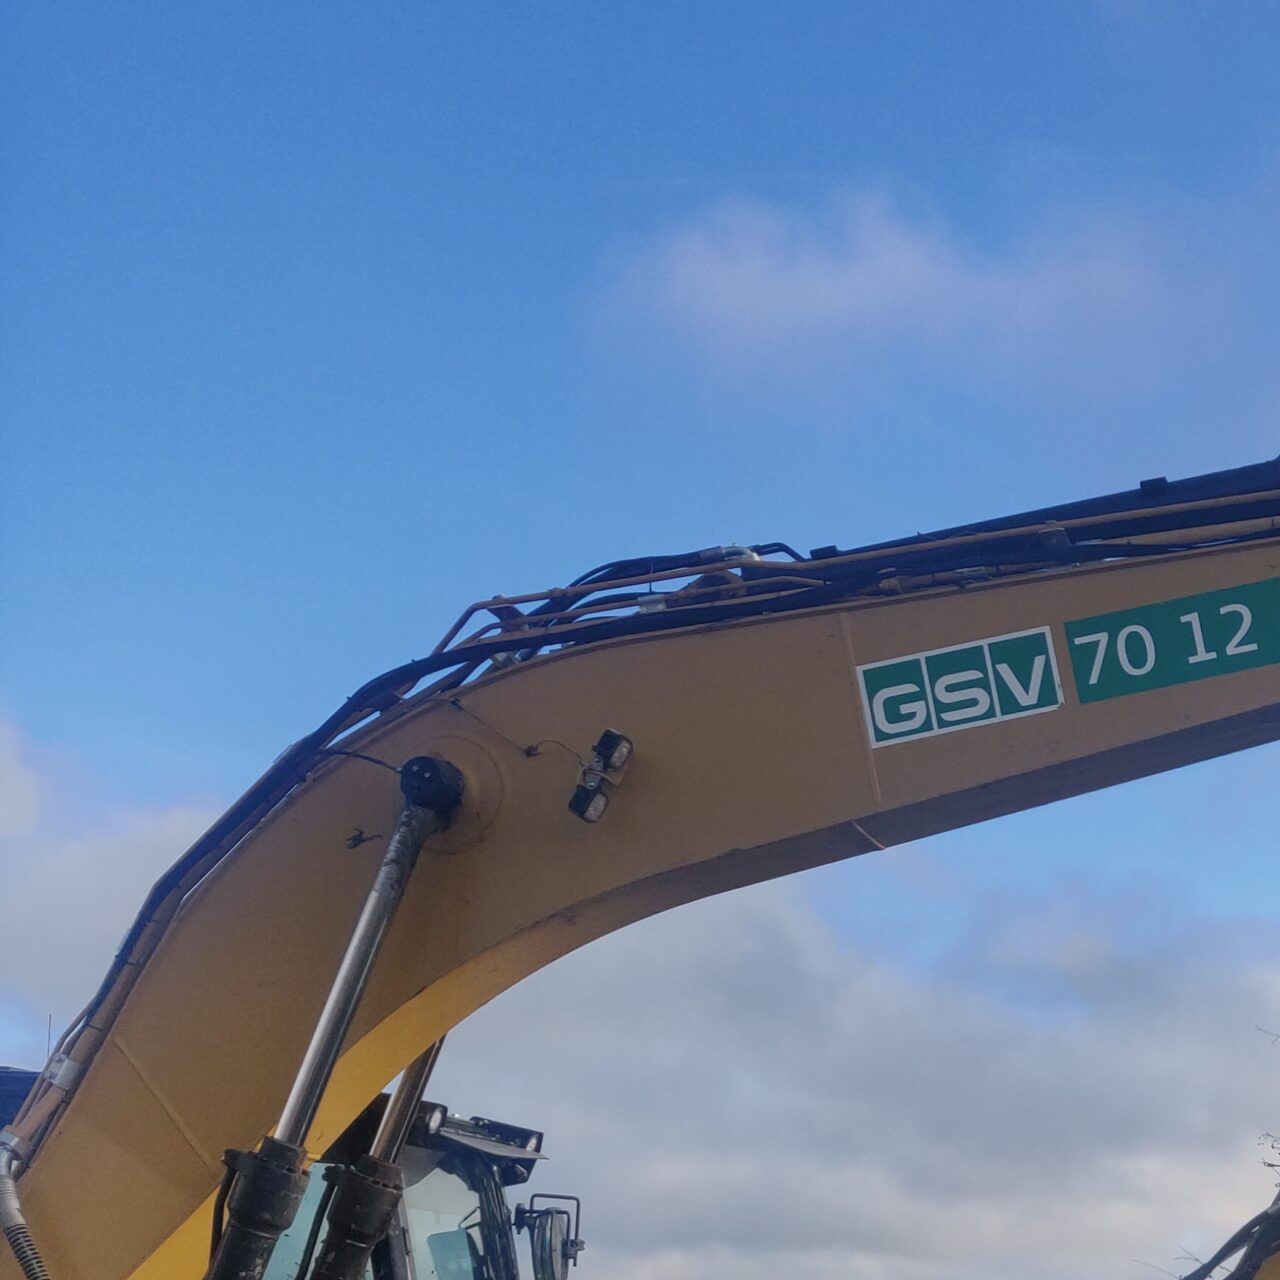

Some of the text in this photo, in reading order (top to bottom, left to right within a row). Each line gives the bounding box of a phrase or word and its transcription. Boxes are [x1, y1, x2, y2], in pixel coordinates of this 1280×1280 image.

[872, 654, 1047, 735] GSV
[1074, 624, 1157, 686] 70
[1180, 603, 1259, 664] 12
